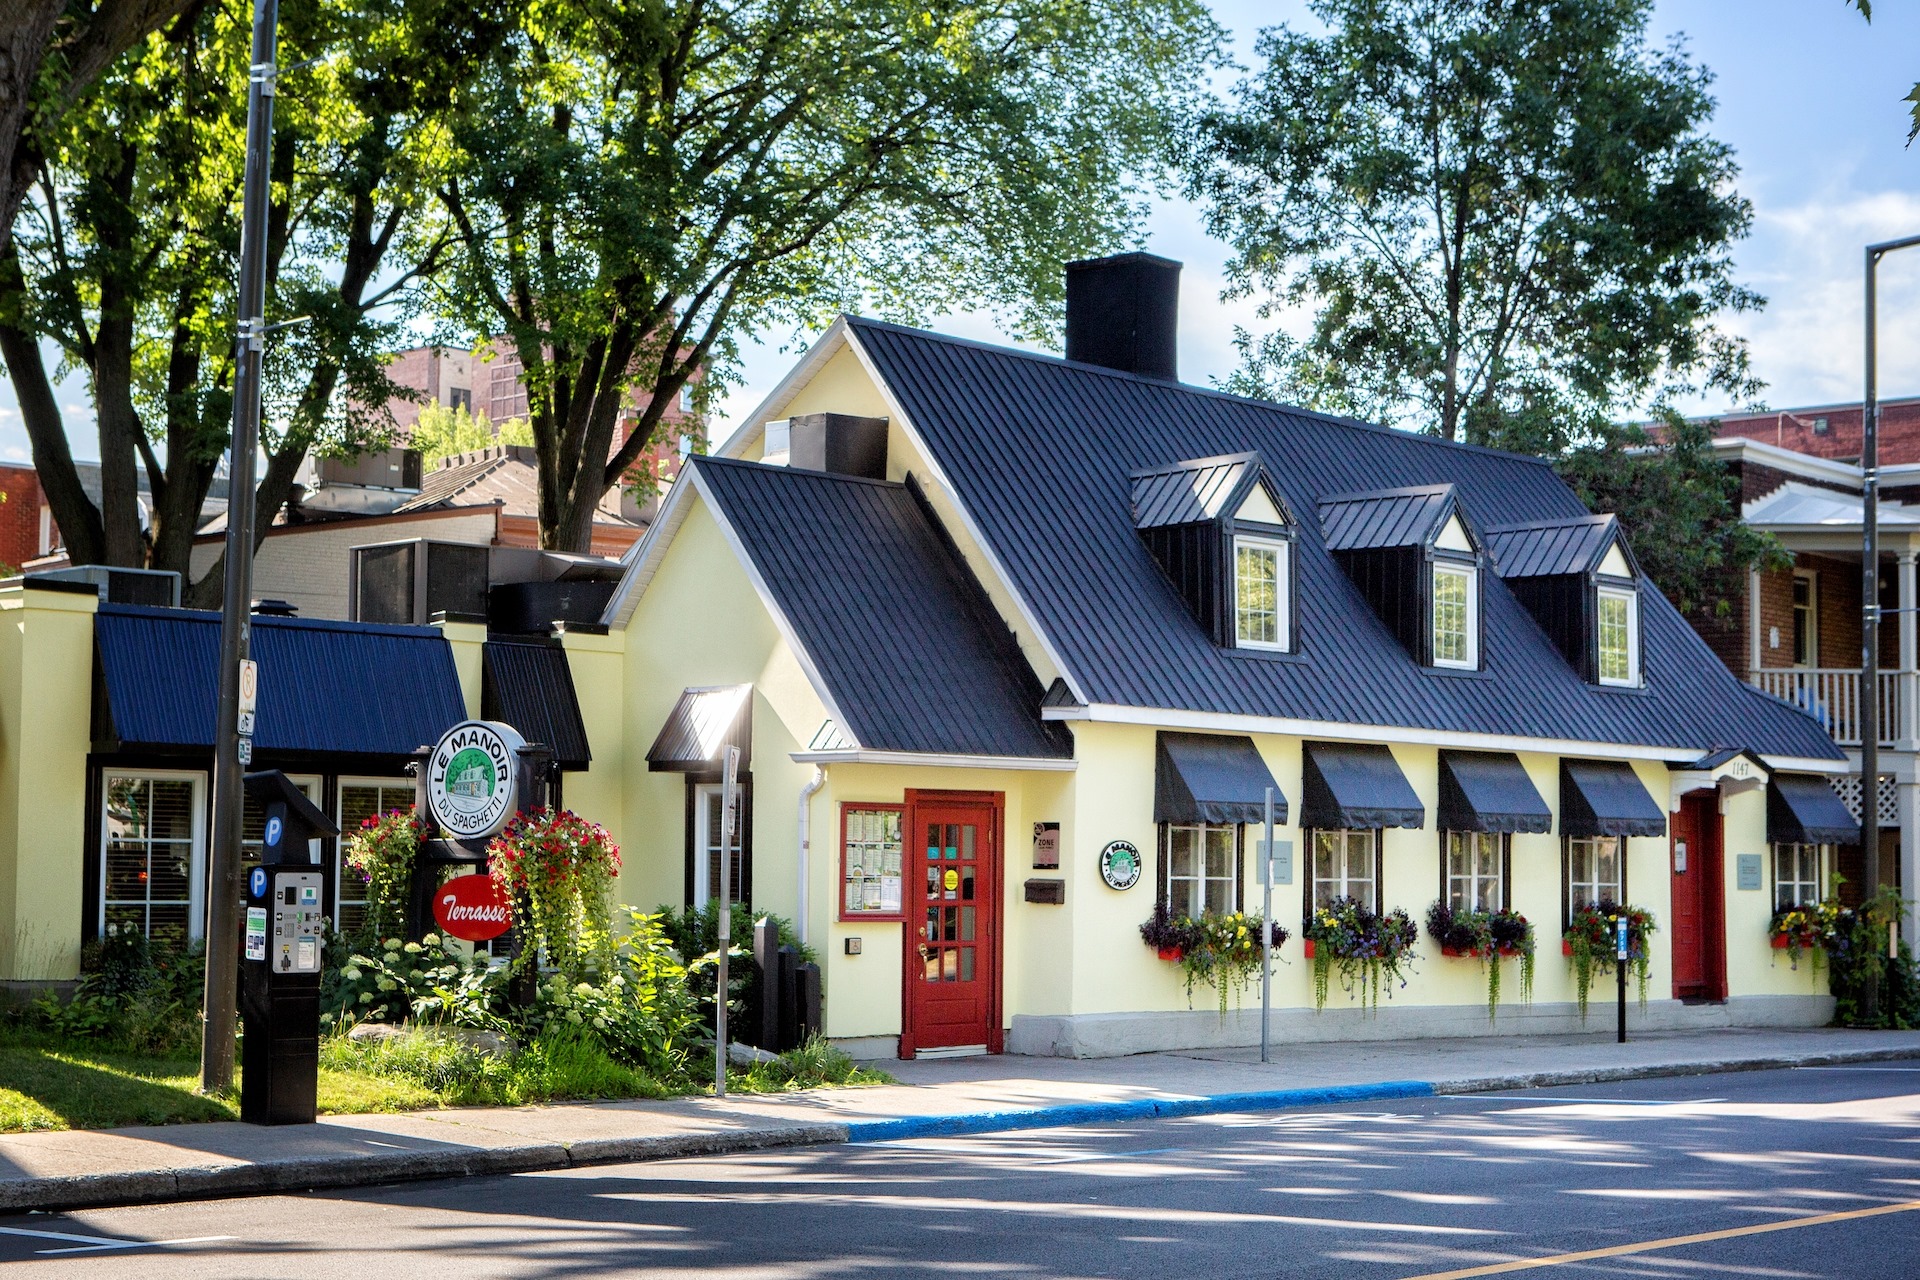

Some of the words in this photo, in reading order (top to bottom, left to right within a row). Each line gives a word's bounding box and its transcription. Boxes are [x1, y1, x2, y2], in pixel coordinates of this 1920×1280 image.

[434, 752, 449, 783] LE
[451, 730, 508, 782] MANOIR
[1732, 761, 1749, 776] 1147
[438, 798, 452, 818] DU
[452, 796, 502, 830] SPAGHETTI
[267, 819, 280, 843] P
[1038, 838, 1055, 846] ZONE
[253, 870, 265, 894] P
[442, 894, 507, 922] Terrasse
